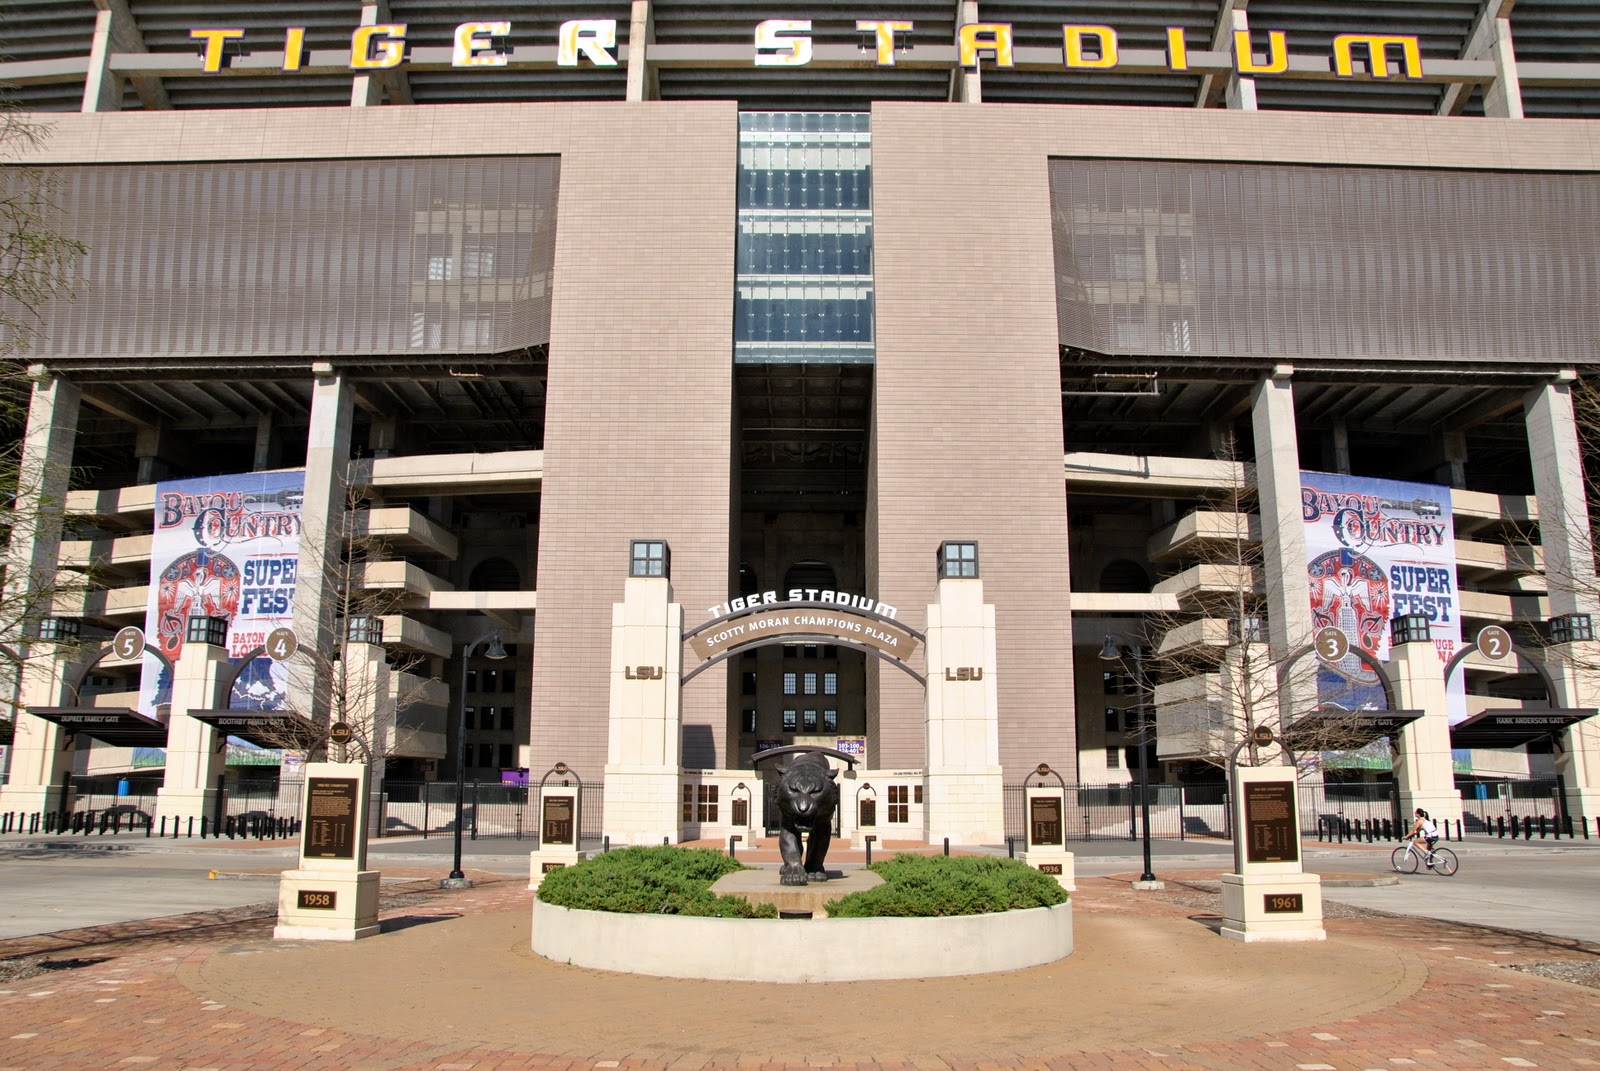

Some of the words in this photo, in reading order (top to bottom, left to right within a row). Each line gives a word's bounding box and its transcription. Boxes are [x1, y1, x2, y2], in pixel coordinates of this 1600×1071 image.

[189, 19, 618, 75] TIGER
[754, 19, 1424, 80] STADIUM
[1331, 507, 1446, 547] COUNTRY
[1390, 565, 1451, 594] SUPER
[708, 590, 777, 619] TIGER
[788, 588, 898, 620] STADIUM
[1391, 593, 1452, 622] FEST
[232, 632, 266, 644] BATON
[706, 624, 745, 647] SCOTTY
[749, 616, 790, 632] MORAN
[794, 615, 862, 633] CHAMPIONS
[865, 626, 899, 647] PLAZA
[123, 638, 134, 656] 5
[274, 638, 287, 657] 4
[1326, 638, 1339, 657] 3
[1489, 637, 1502, 656] 2
[625, 665, 663, 680] LSU
[945, 667, 983, 681] LSU
[1254, 732, 1271, 740] LSU
[1042, 865, 1060, 874] 1936
[303, 893, 330, 906] 1958
[1271, 897, 1297, 909] 1961
